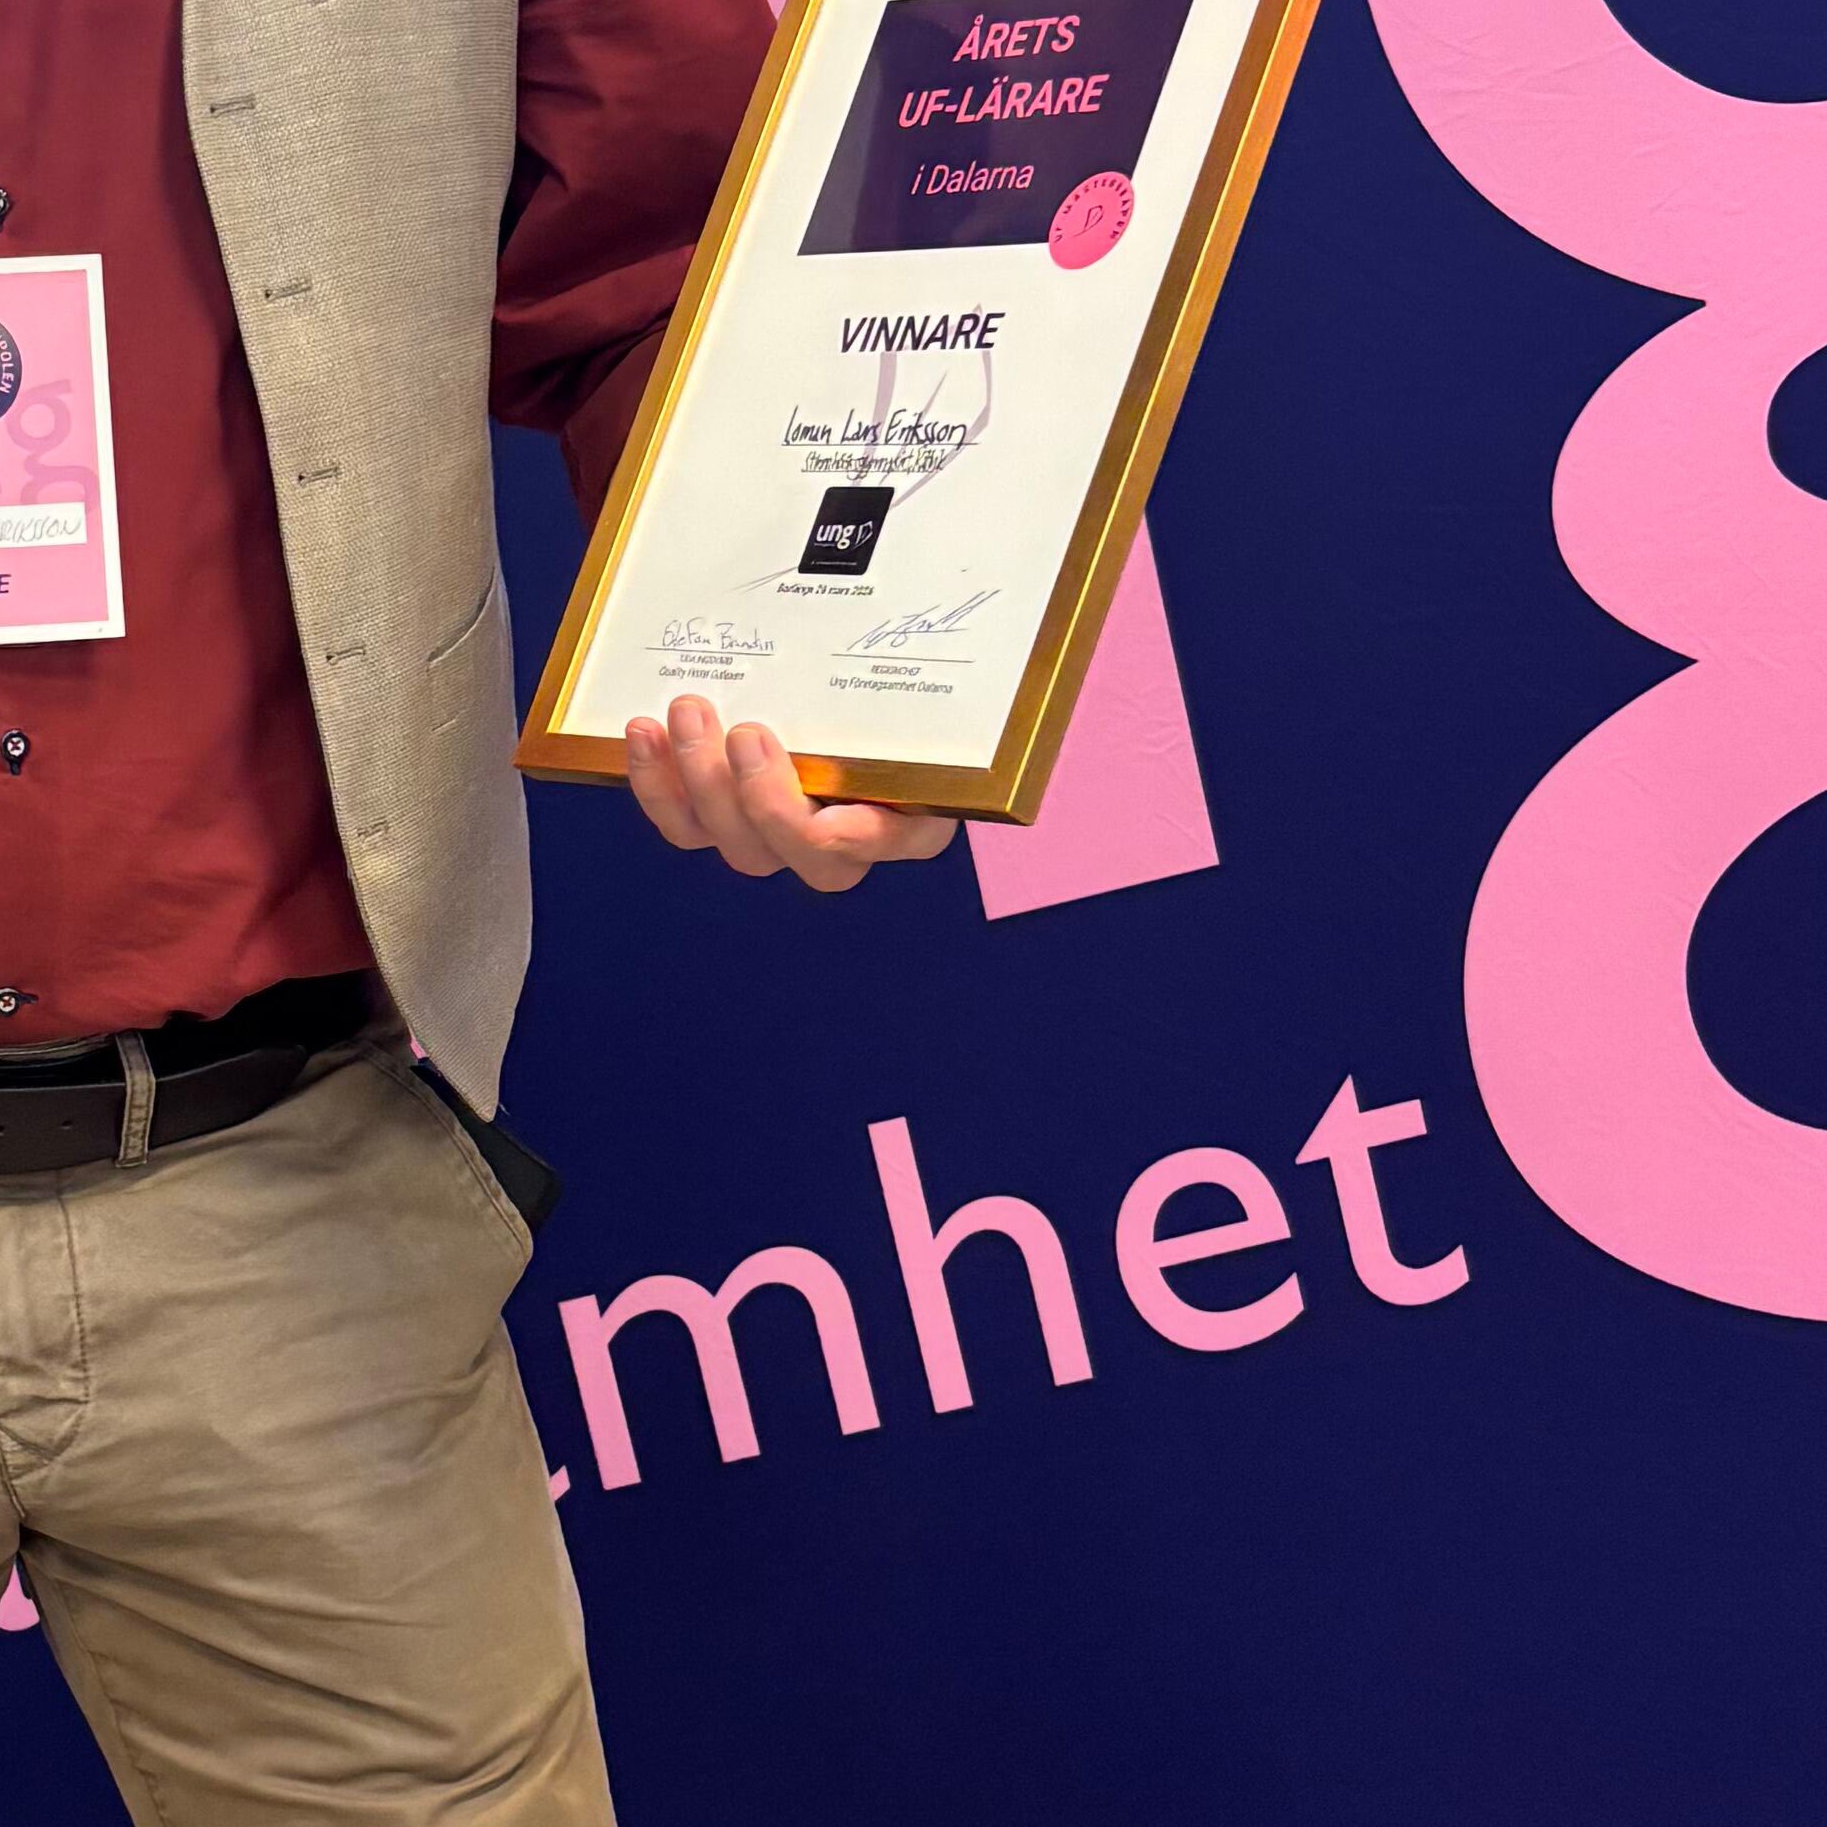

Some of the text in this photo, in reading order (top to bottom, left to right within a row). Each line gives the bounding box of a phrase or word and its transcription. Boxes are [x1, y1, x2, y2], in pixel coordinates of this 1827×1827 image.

[953, 14, 1080, 62] ÅRETS
[898, 74, 1109, 128] UF-LÄRARE
[911, 162, 1035, 195] i Dalarna
[840, 312, 1005, 353] VINNARE
[841, 408, 882, 445] Lars
[884, 409, 968, 451] Eriksson
[816, 524, 858, 550] ung
